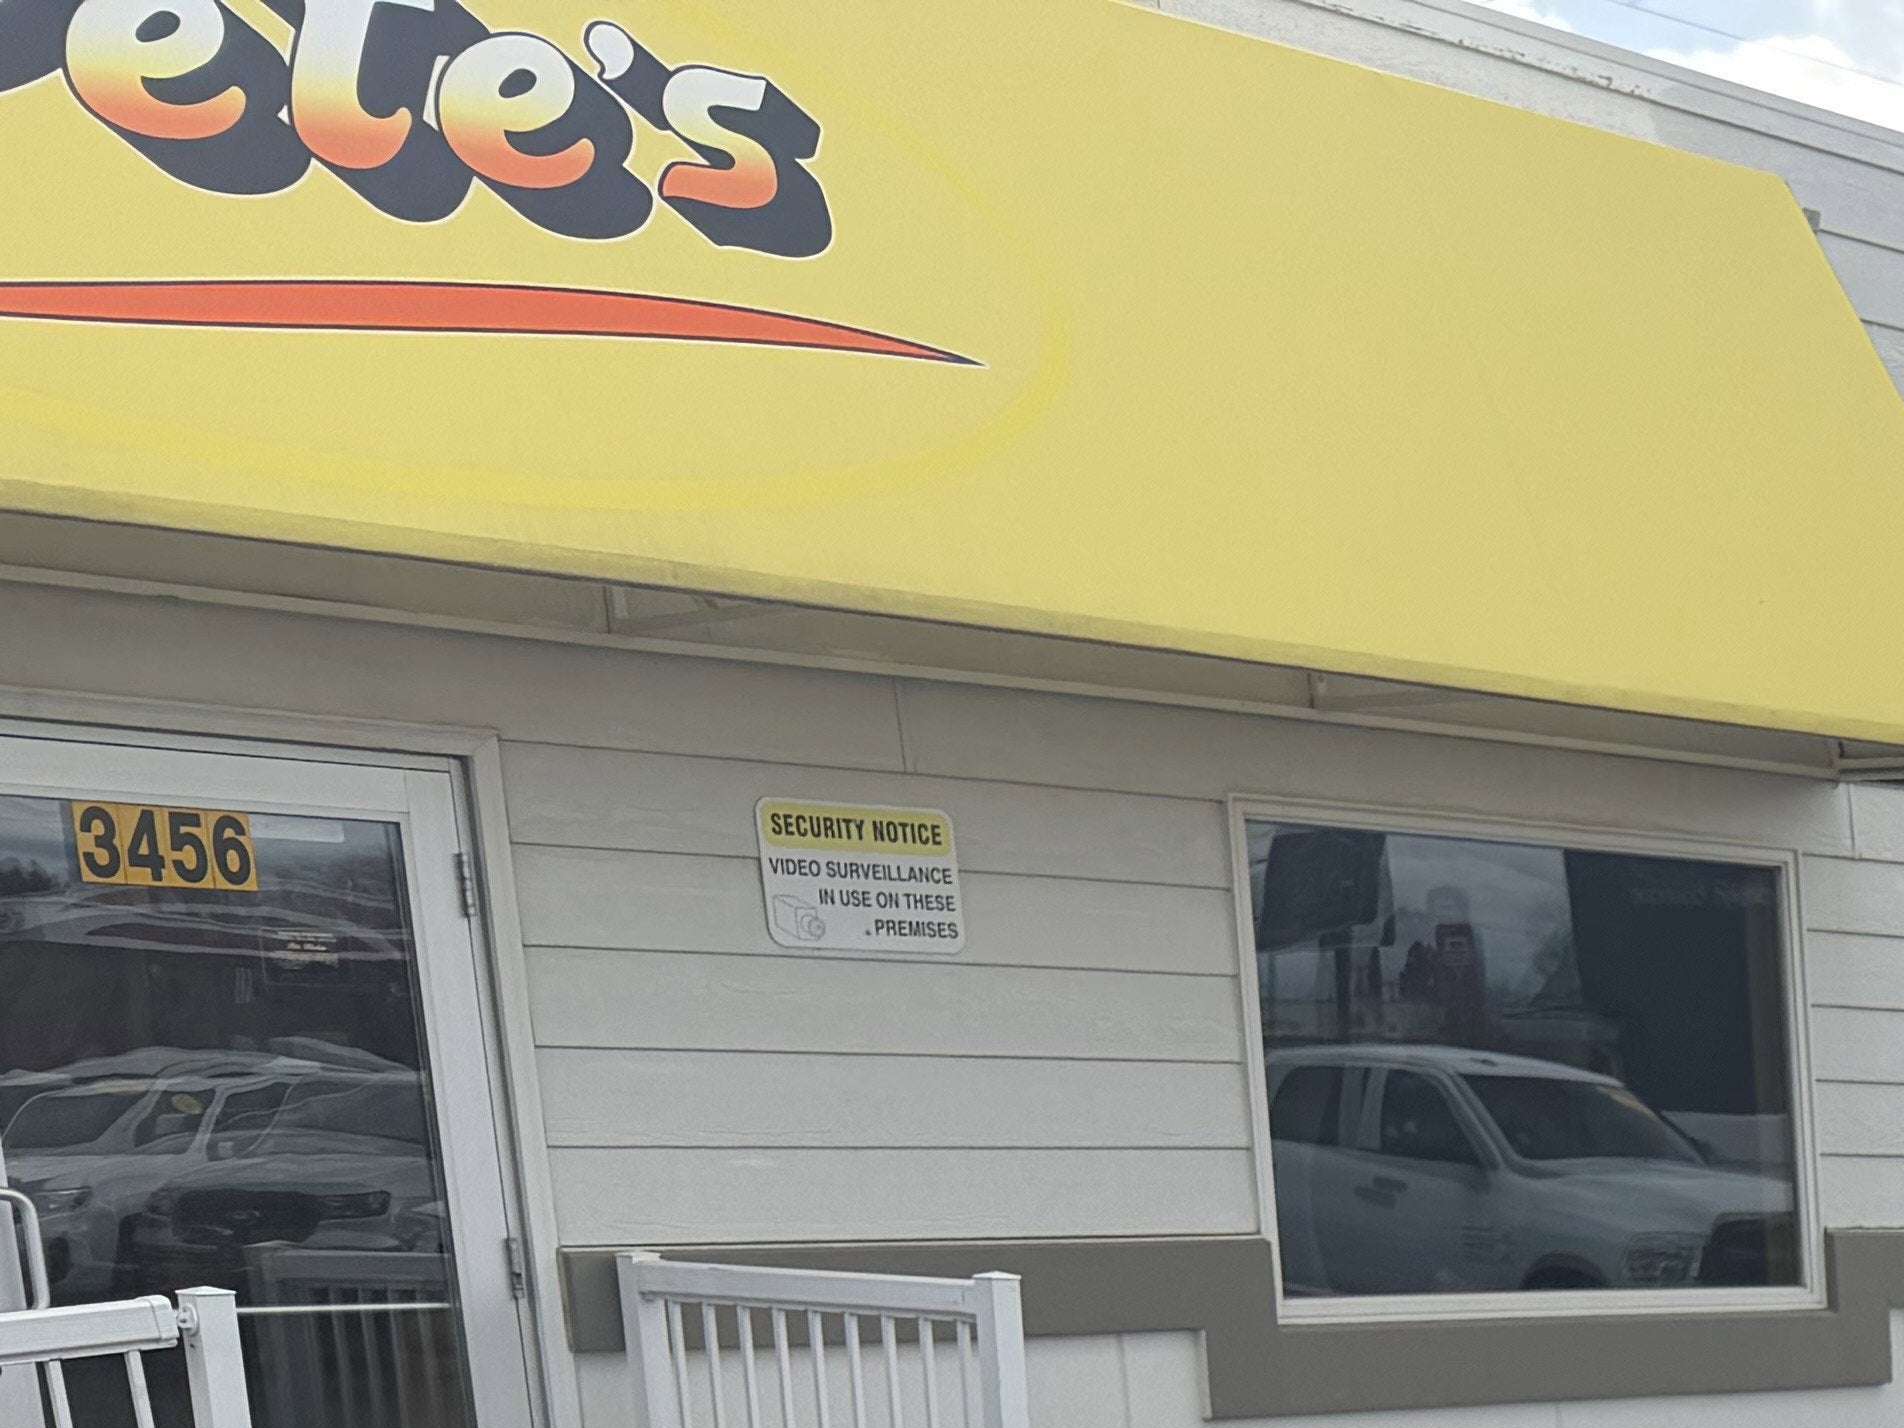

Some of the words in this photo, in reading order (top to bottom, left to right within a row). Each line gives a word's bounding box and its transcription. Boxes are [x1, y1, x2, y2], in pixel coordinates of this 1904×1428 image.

[5, 0, 810, 245] ete's
[770, 812, 865, 842] SECURITY
[872, 819, 943, 847] NOTICE
[79, 805, 251, 886] 3456
[768, 857, 821, 878] VIDEO
[825, 860, 954, 885] SURVEILLANCE
[818, 888, 835, 906] IN
[839, 889, 872, 908] USE
[876, 891, 899, 910] ON
[903, 892, 957, 913] THESE
[874, 918, 960, 940] PREMISES
